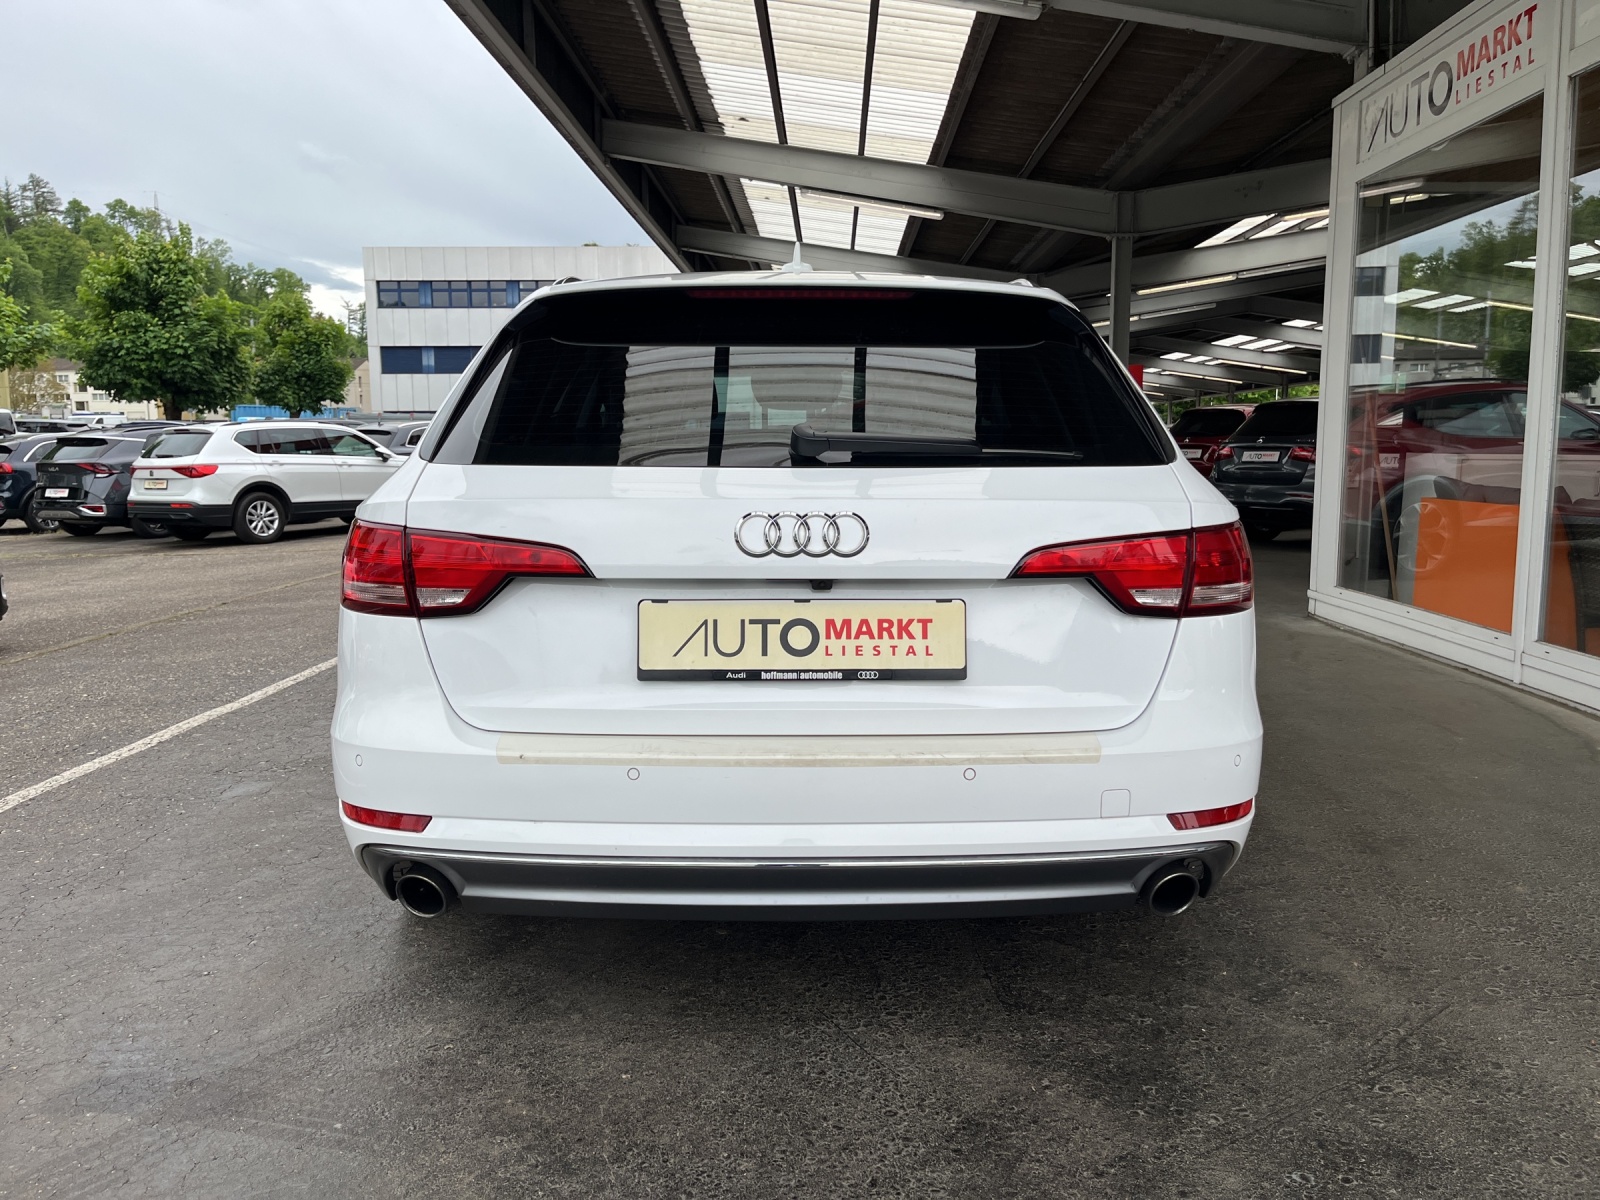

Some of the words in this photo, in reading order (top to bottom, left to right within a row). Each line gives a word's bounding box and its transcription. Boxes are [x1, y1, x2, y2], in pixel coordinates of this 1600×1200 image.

[1367, 60, 1454, 153] AUTO
[1456, 3, 1538, 81] MARKT
[1455, 47, 1535, 105] LIESTAL
[672, 618, 821, 657] AUTO
[824, 617, 934, 641] MARKT
[824, 645, 933, 656] LIESTAL
[725, 671, 747, 679] Audi
